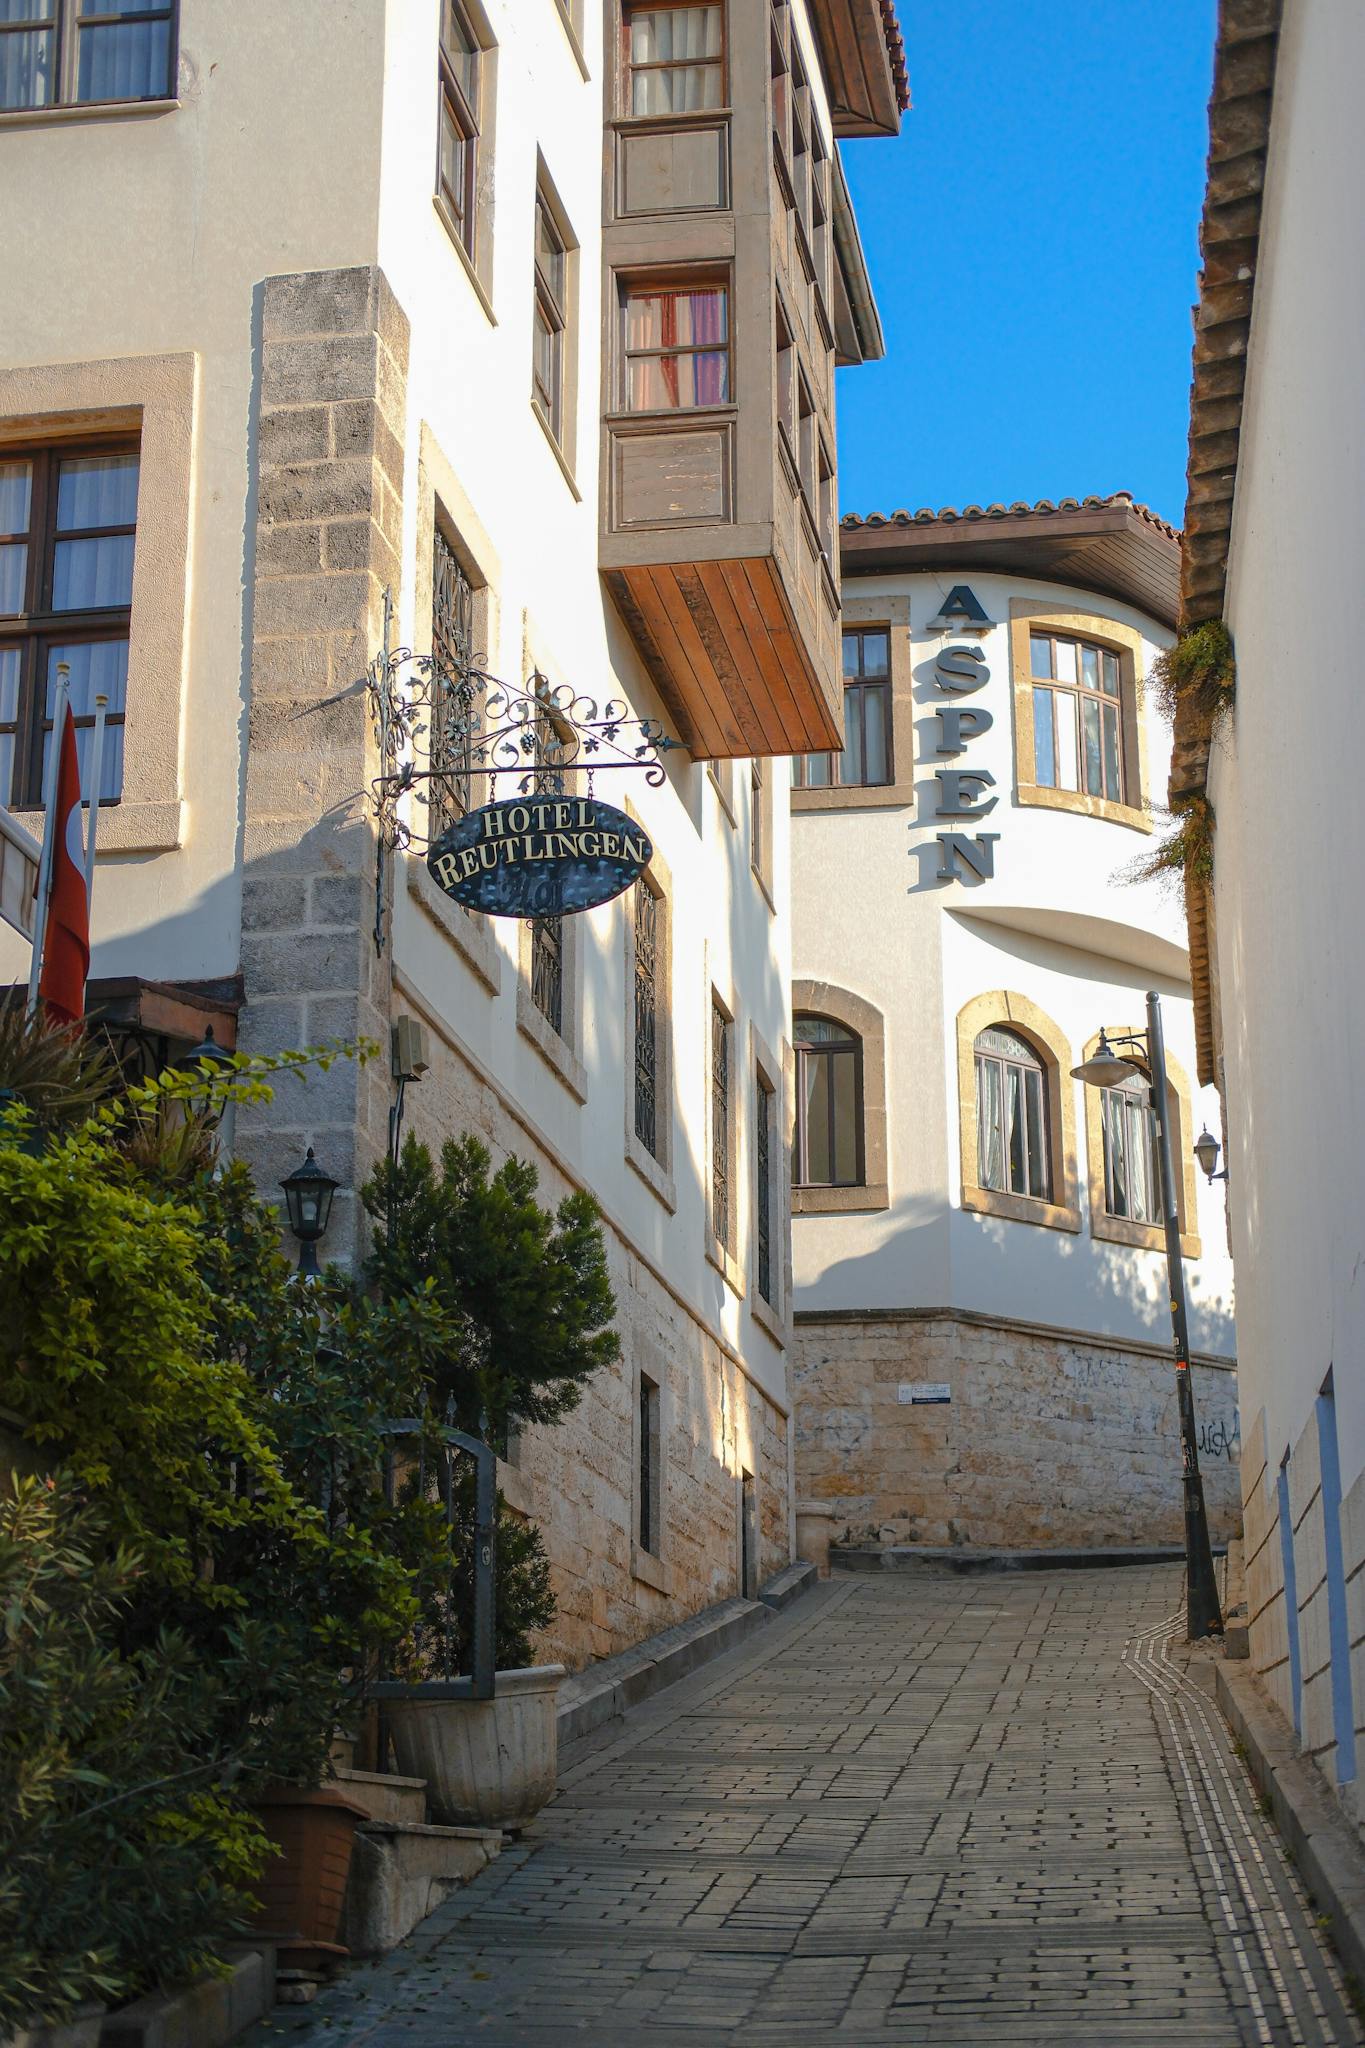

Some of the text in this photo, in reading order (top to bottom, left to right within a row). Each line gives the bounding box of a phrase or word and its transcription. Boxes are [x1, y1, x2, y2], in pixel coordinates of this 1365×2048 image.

[926, 585, 1001, 880] ASPEN
[481, 801, 596, 839] HOTEL
[434, 831, 646, 890] REUTLINGEN
